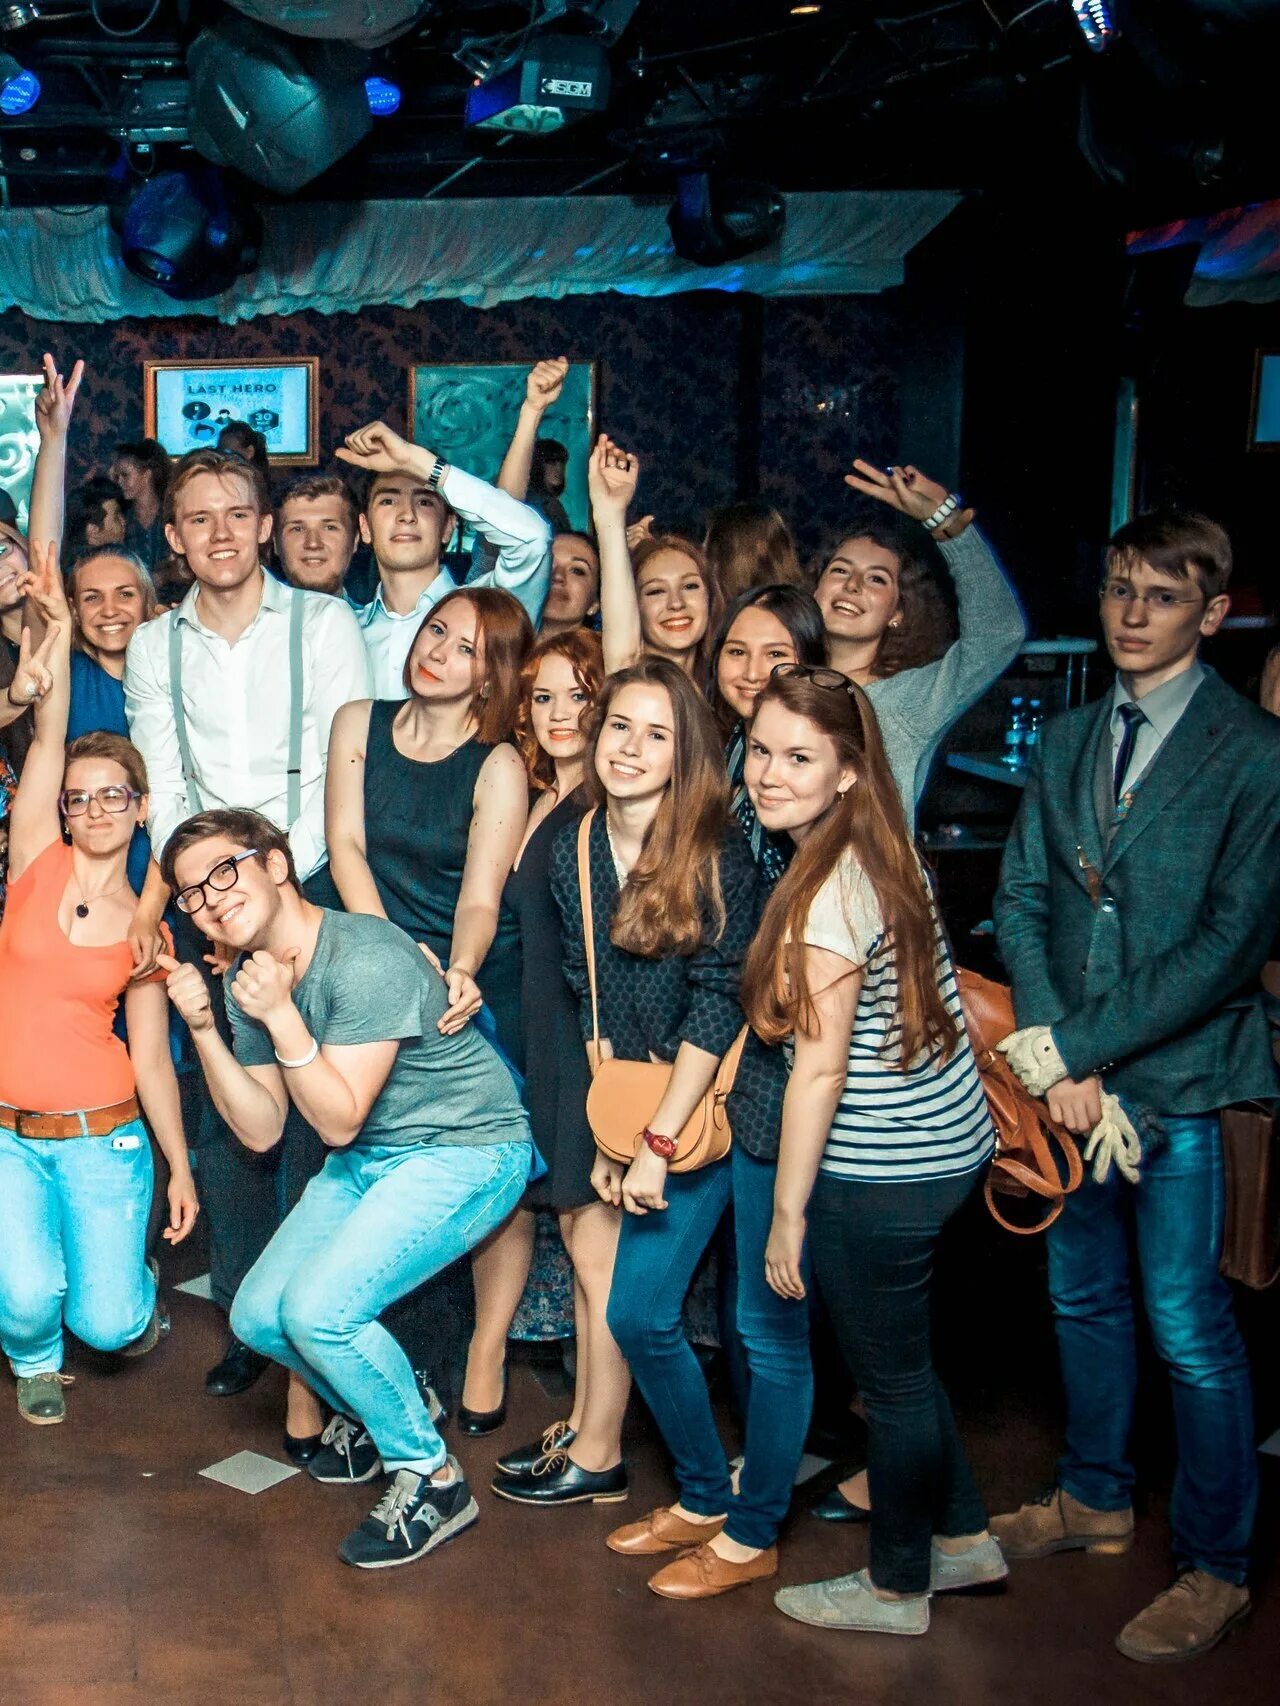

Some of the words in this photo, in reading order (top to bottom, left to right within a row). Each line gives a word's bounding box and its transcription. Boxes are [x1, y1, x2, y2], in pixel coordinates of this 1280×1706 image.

[556, 83, 588, 95] SGM
[187, 385, 226, 394] LAST
[233, 384, 277, 393] HERO
[255, 412, 273, 420] 30
